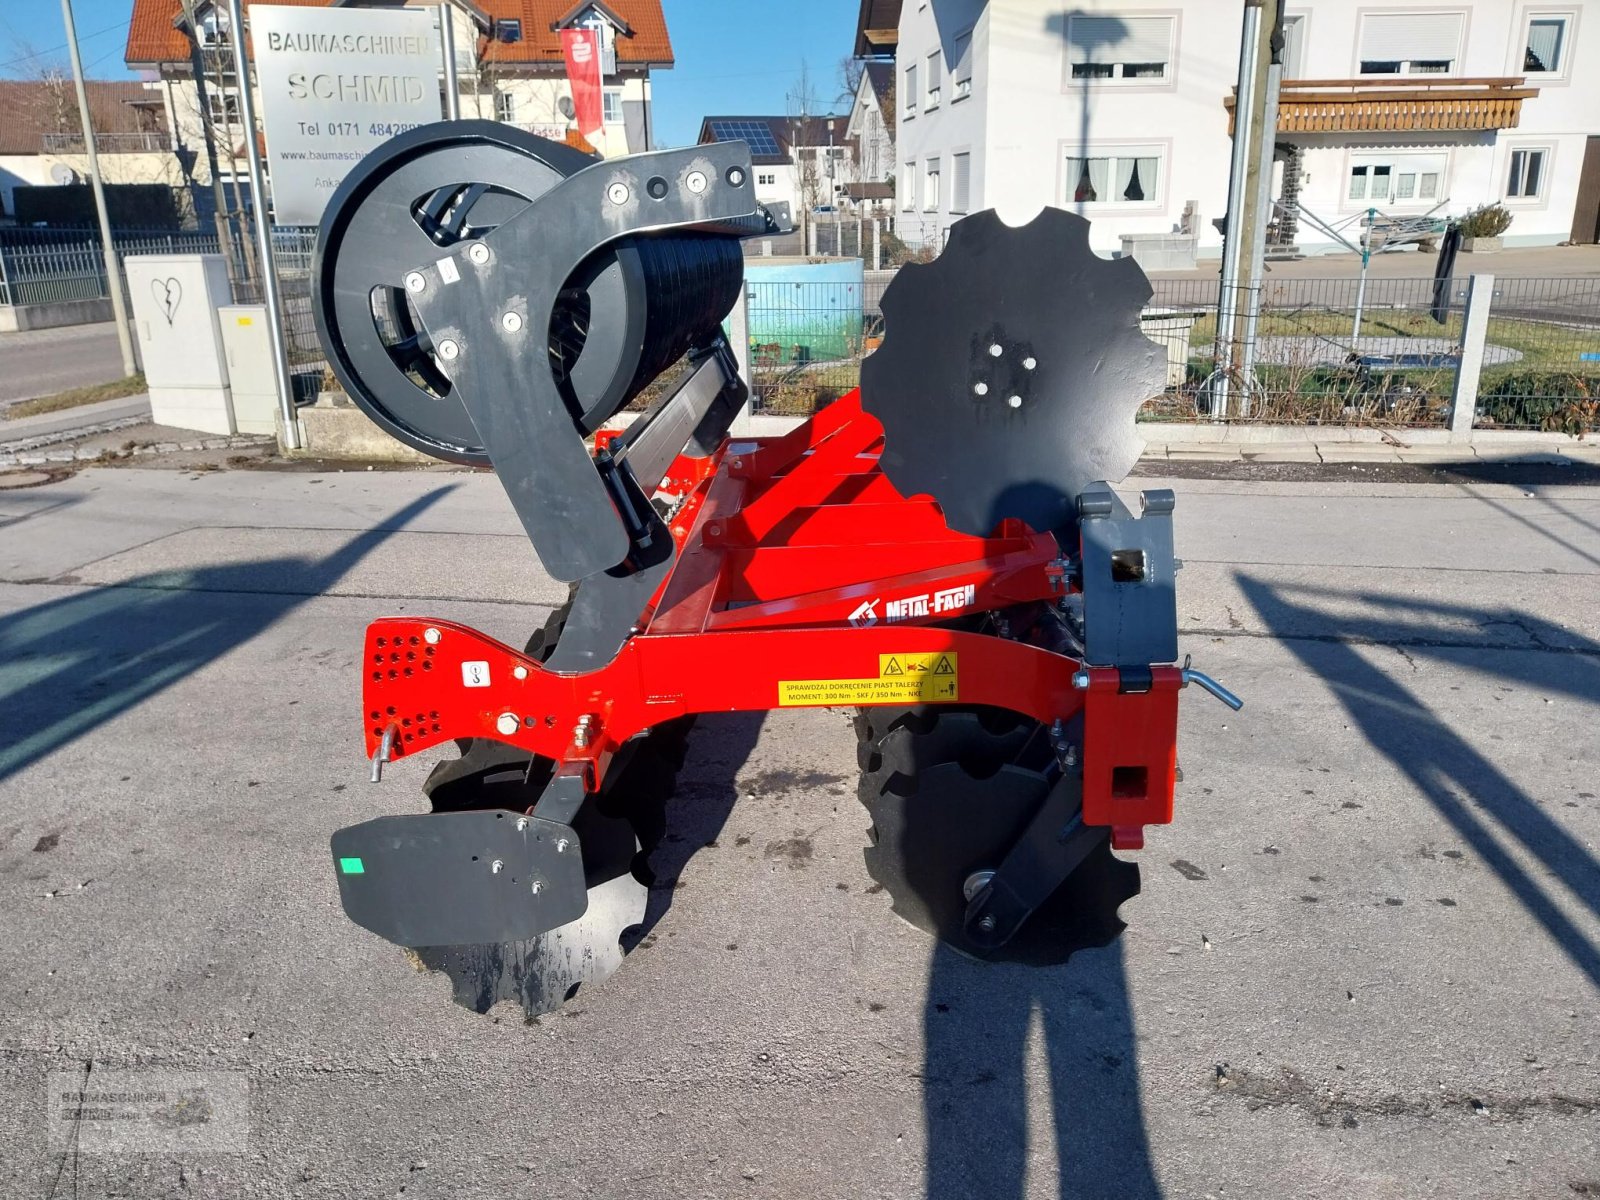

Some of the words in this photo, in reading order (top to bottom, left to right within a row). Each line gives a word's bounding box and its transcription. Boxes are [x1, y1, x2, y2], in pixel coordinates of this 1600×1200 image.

[268, 31, 429, 56] BAUMASCHINEN
[287, 73, 425, 103] SCHMID
[297, 122, 320, 136] Tel
[328, 122, 360, 136] 0171
[368, 122, 424, 137] 48428
[886, 584, 975, 624] METAL-FACH
[786, 683, 828, 692] SPRAWDŻAJ
[829, 682, 873, 691] DOKRĘCENIE
